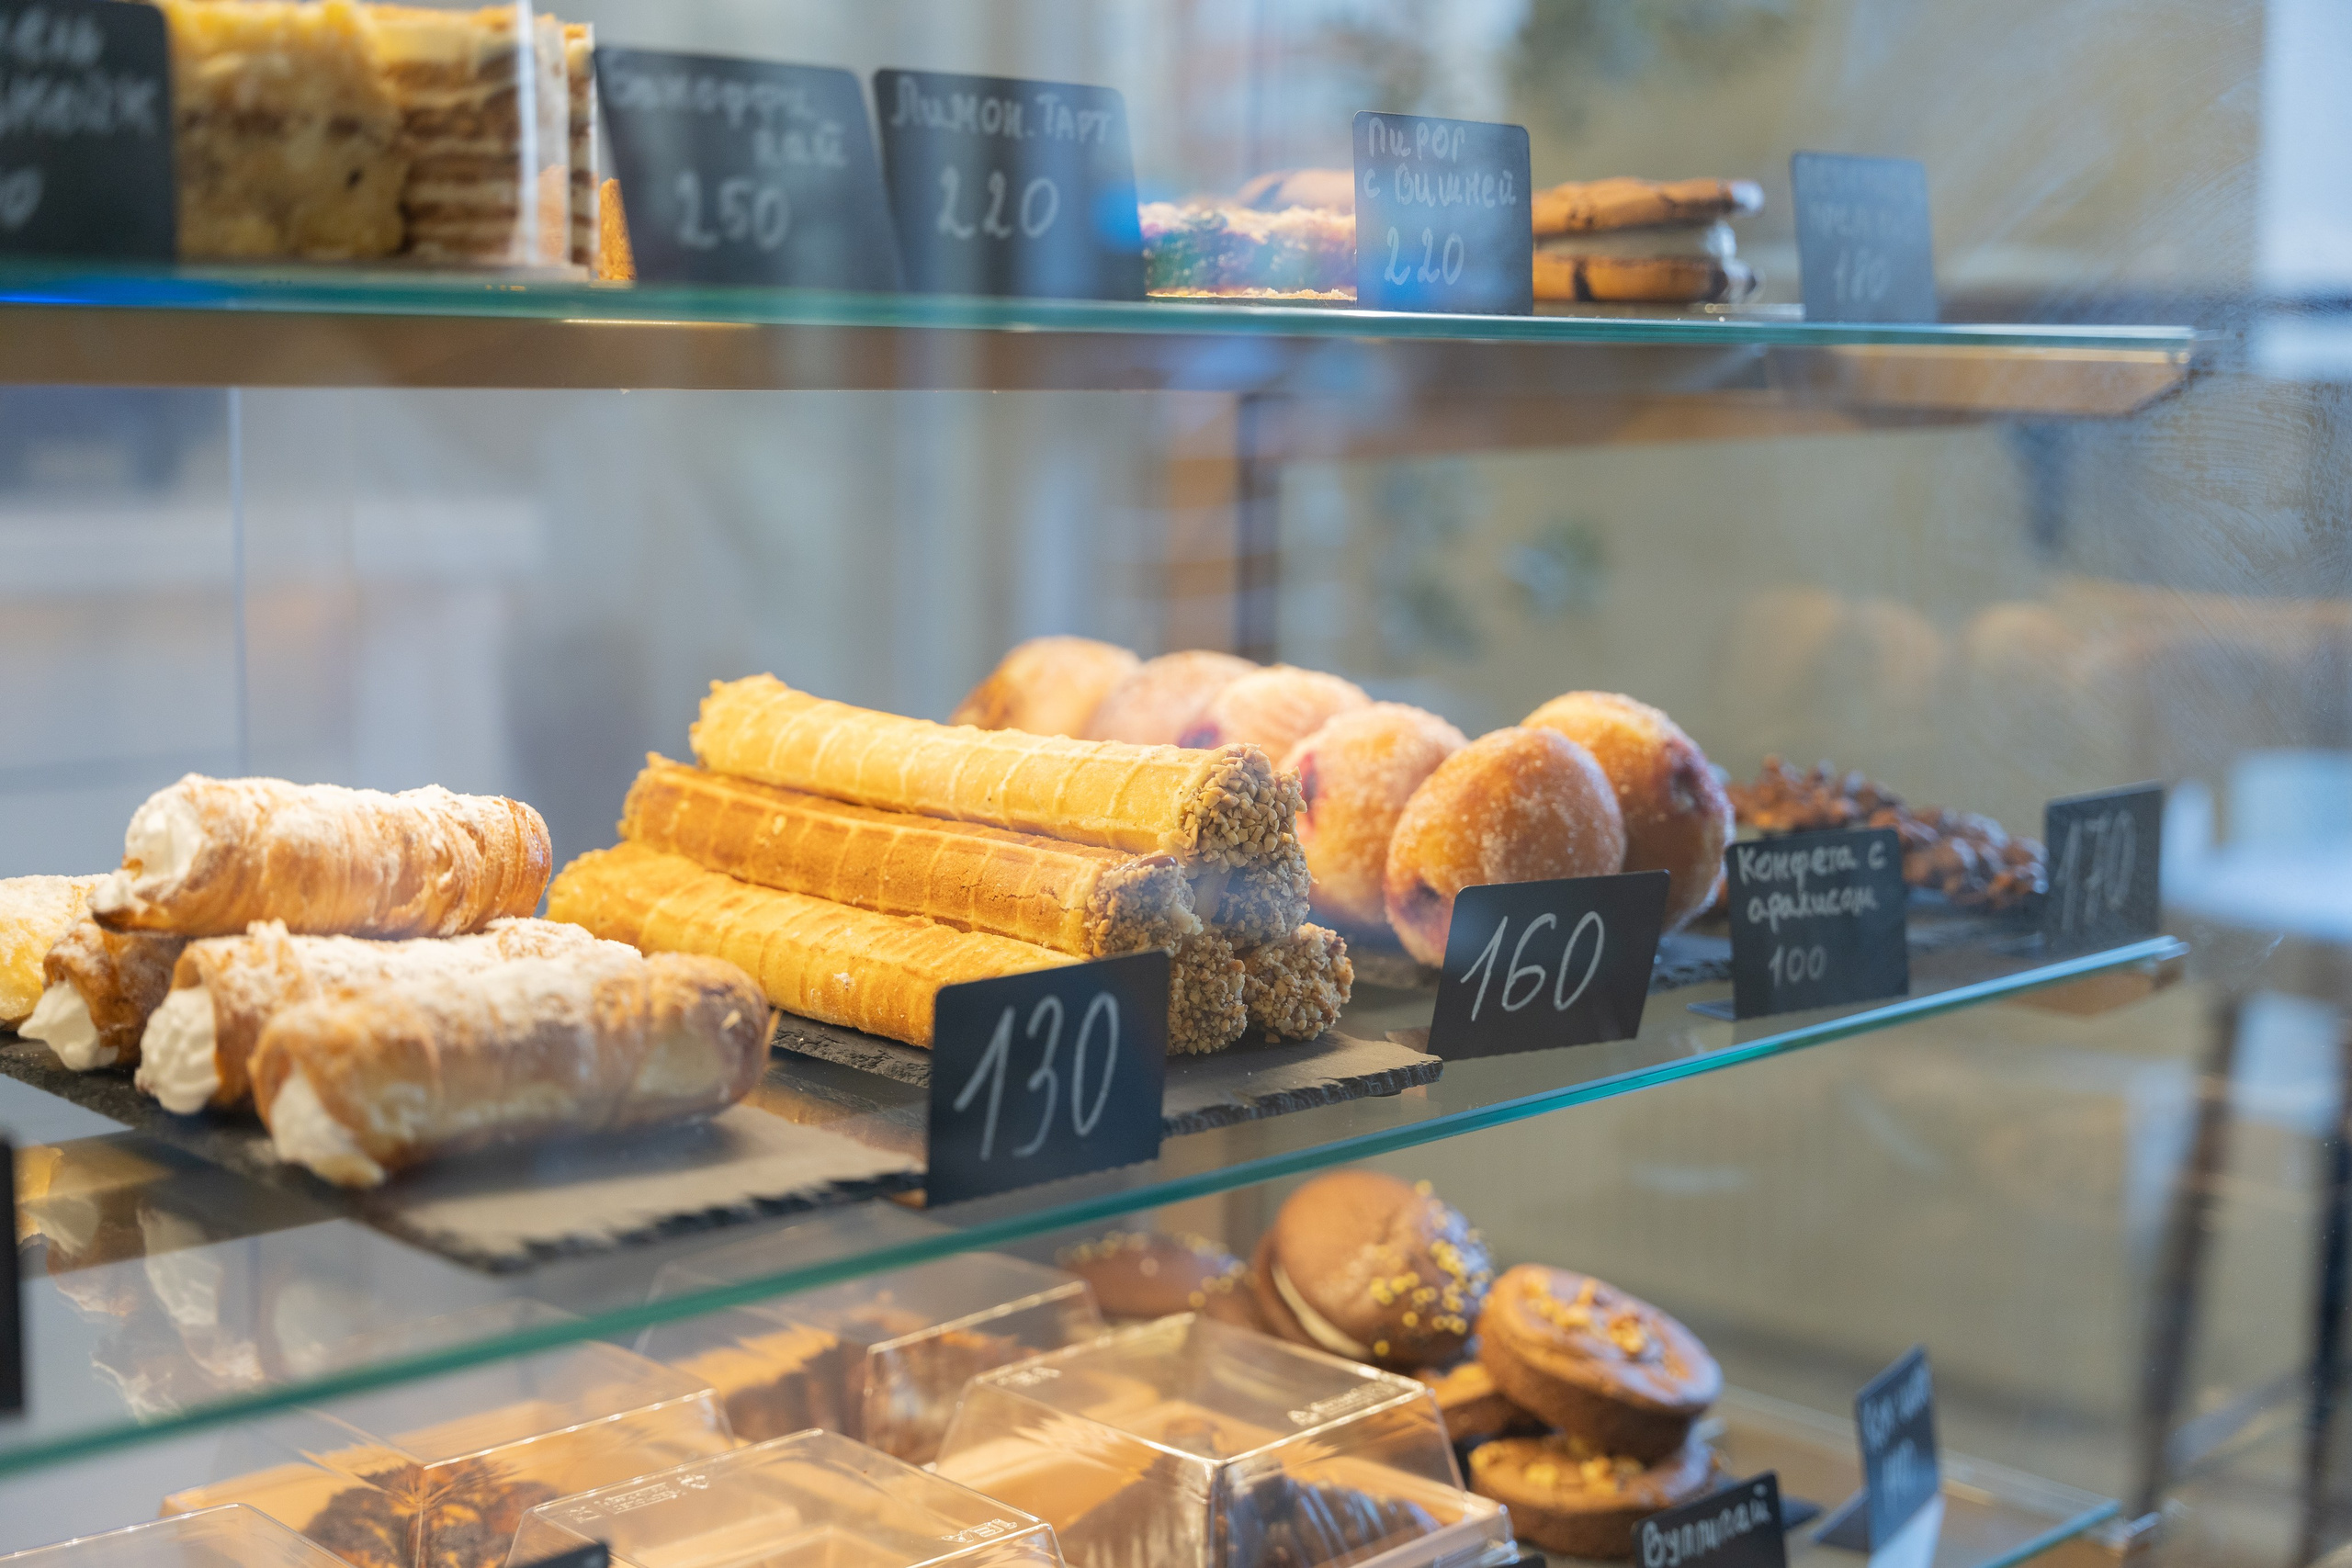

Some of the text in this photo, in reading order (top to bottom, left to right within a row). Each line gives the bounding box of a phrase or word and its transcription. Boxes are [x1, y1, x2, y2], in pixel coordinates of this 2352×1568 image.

[675, 168, 791, 252] 250
[935, 164, 1061, 241] 220
[1384, 226, 1465, 287] 220
[2055, 810, 2138, 932] 170
[1459, 909, 1606, 1022] 160
[1769, 944, 1827, 988] 100
[953, 991, 1121, 1162] 130
